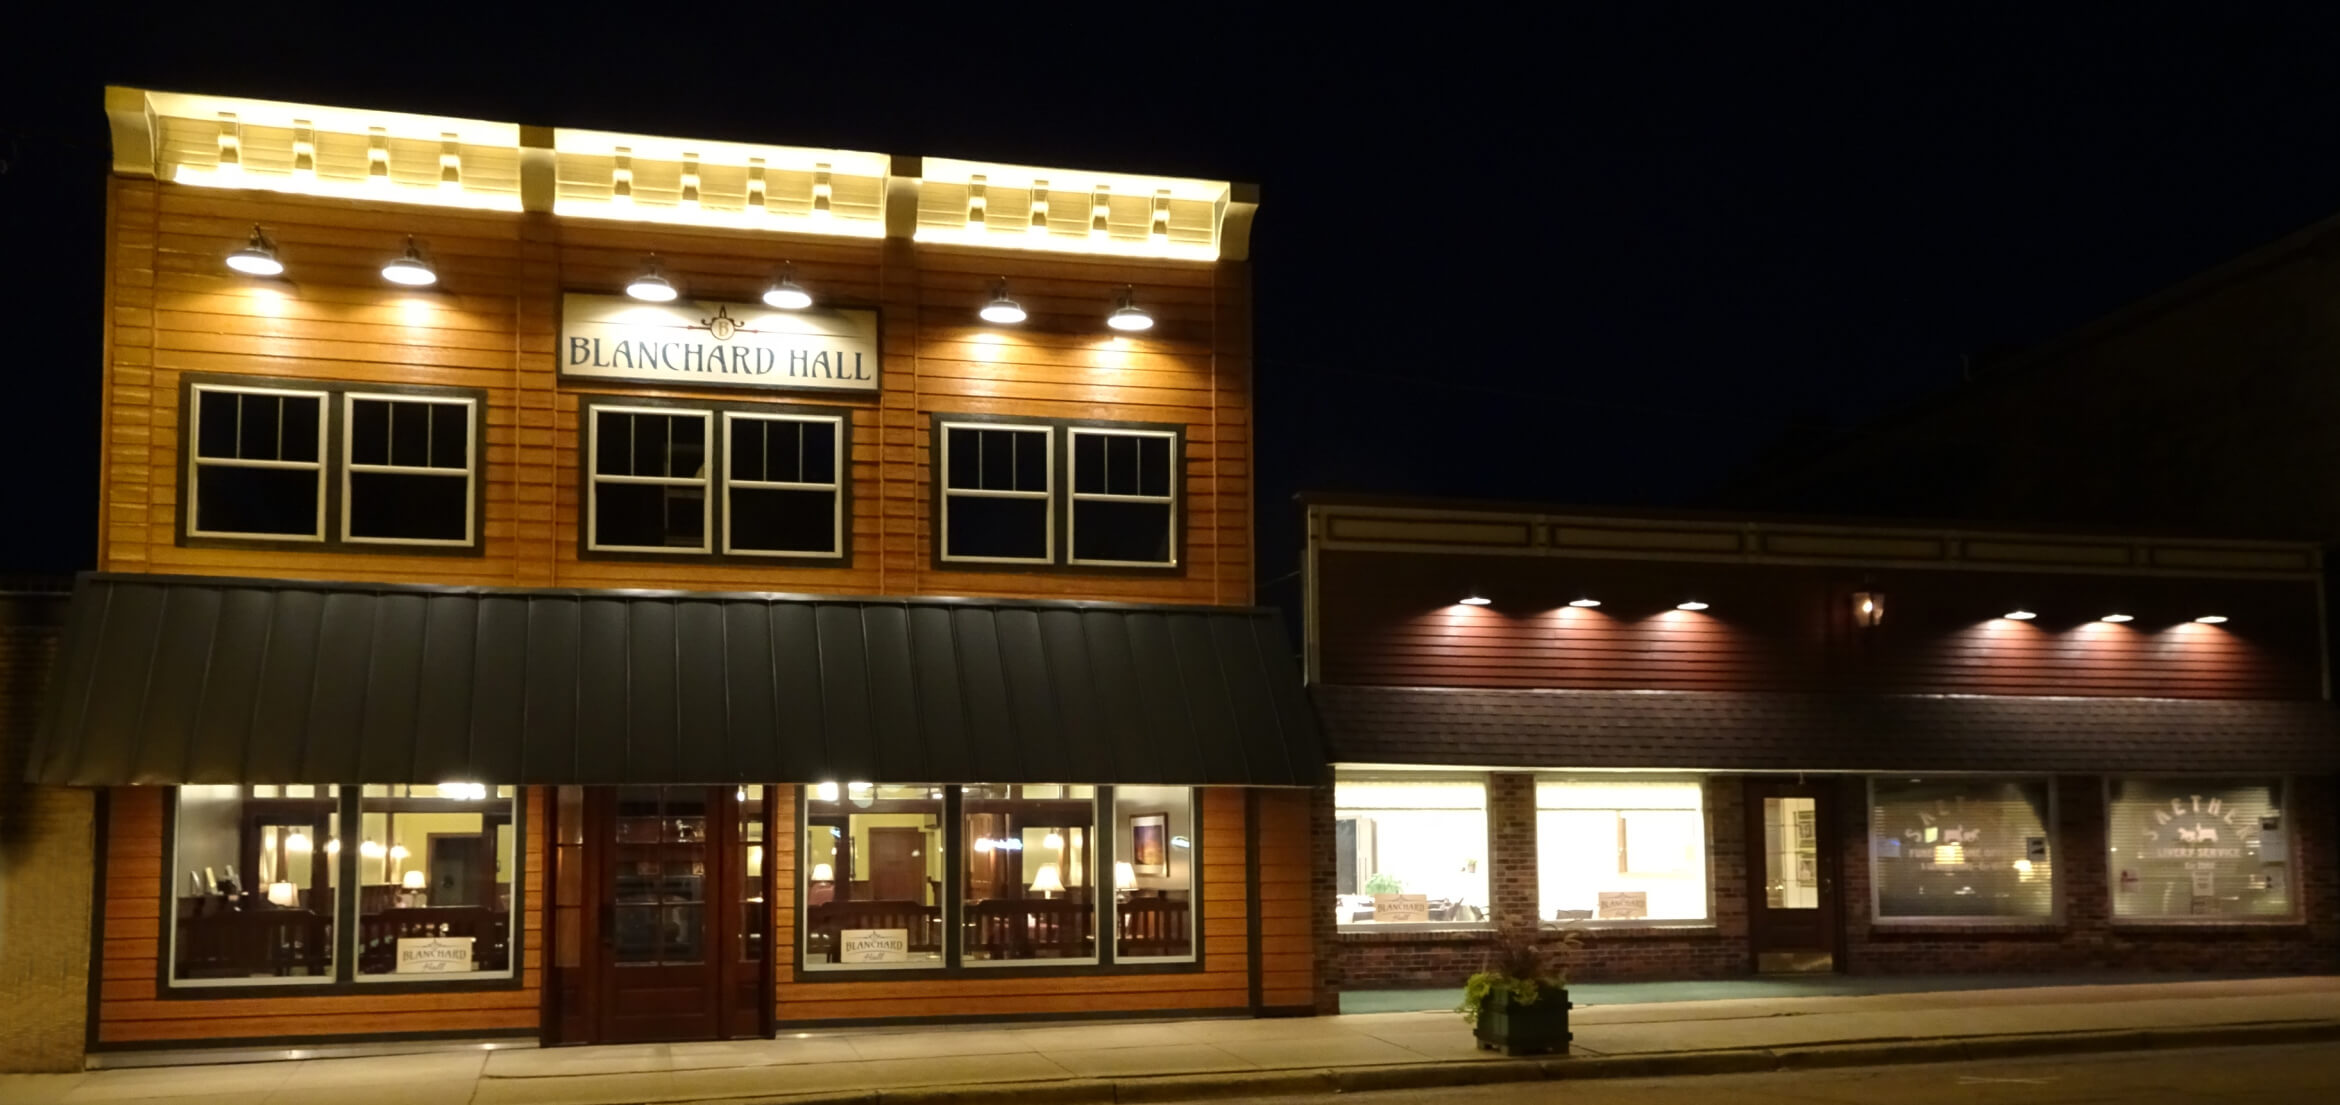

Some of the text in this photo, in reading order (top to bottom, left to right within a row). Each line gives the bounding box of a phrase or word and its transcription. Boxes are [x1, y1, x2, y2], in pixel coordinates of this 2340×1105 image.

[718, 320, 729, 337] B
[569, 336, 871, 381] BLANCHARD HALL
[846, 941, 903, 952] BLANCHARD
[403, 949, 466, 961] BLANCHARD
